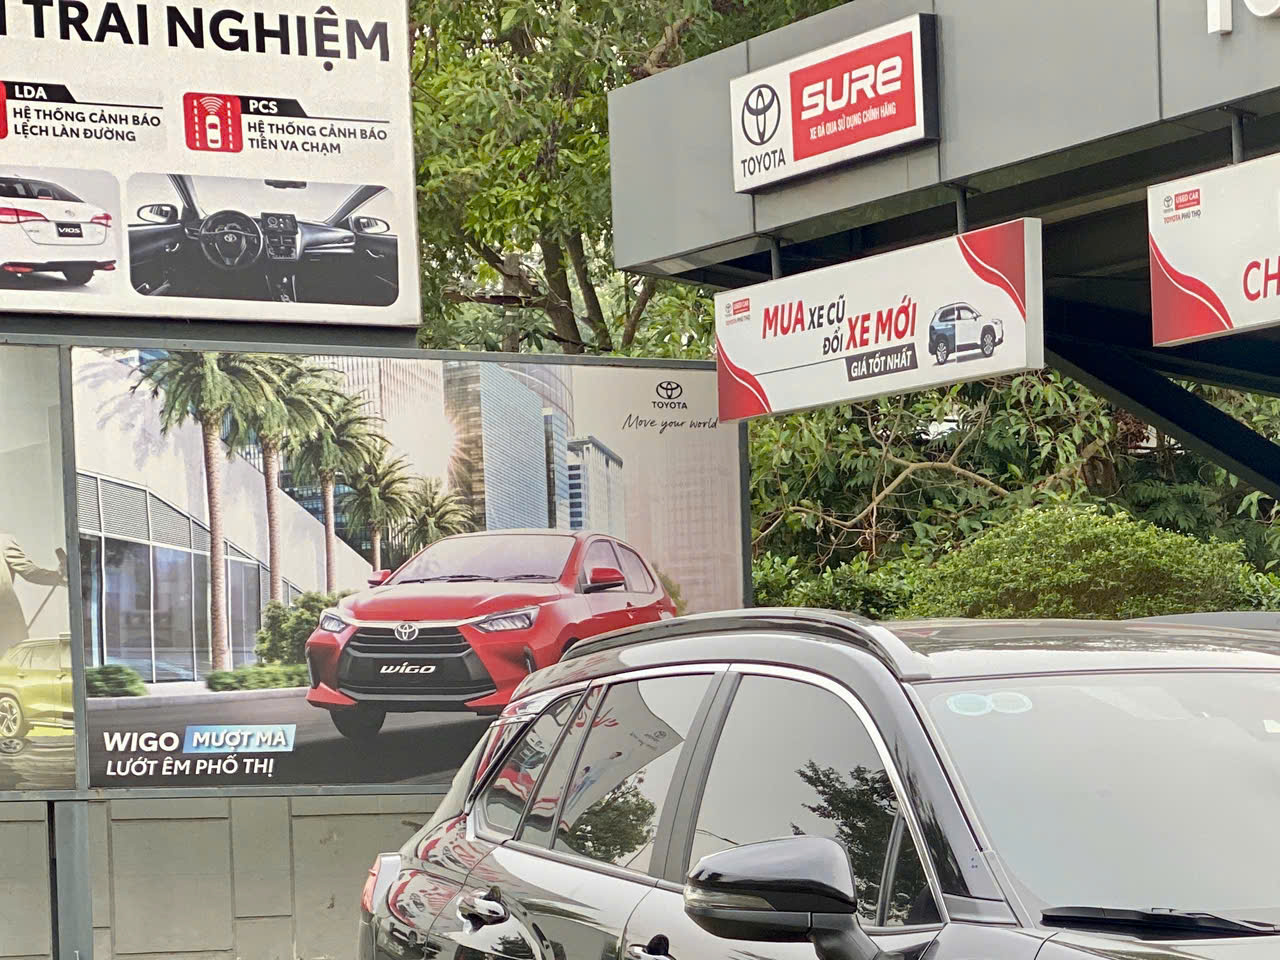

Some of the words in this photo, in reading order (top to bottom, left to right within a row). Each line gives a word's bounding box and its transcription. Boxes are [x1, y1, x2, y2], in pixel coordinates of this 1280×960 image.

[166, 5, 390, 72] NGHIỆM
[14, 85, 48, 99] LDA
[13, 105, 32, 122] HỆ
[34, 107, 86, 123] THỐNG
[88, 110, 129, 126] CẢNH
[132, 113, 161, 127] BÁO
[249, 99, 278, 114] PCS
[14, 122, 49, 138] LỆCH
[52, 124, 80, 138] LÀN
[83, 127, 136, 142] ĐƯỜNG
[247, 120, 265, 135] HỆ
[267, 121, 316, 137] THỐNG
[319, 124, 357, 139] CẢNH
[360, 127, 388, 140] BÁO
[281, 140, 299, 151] VA
[301, 141, 341, 156] CHẠM
[741, 147, 786, 178] TOYOTA
[762, 299, 806, 340] MUA
[807, 304, 825, 330] XE
[826, 294, 846, 326] CŨ
[822, 326, 844, 356] ĐỔI
[845, 312, 871, 350] XE
[874, 294, 917, 344] MỚI
[851, 356, 867, 378] GIÁ
[868, 351, 887, 374] TỐT
[886, 346, 913, 371] NHẤT
[651, 401, 688, 409] TOYOTA
[622, 414, 657, 430] Move
[659, 419, 687, 434] your
[689, 417, 719, 429] world
[103, 731, 180, 752] WIGO
[192, 730, 253, 750] MƯỢT
[255, 727, 287, 747] MÀ
[106, 757, 159, 776] LƯỚT
[161, 757, 191, 776] ÊM
[195, 754, 239, 775] PHỐ
[242, 758, 274, 778] THỊ
